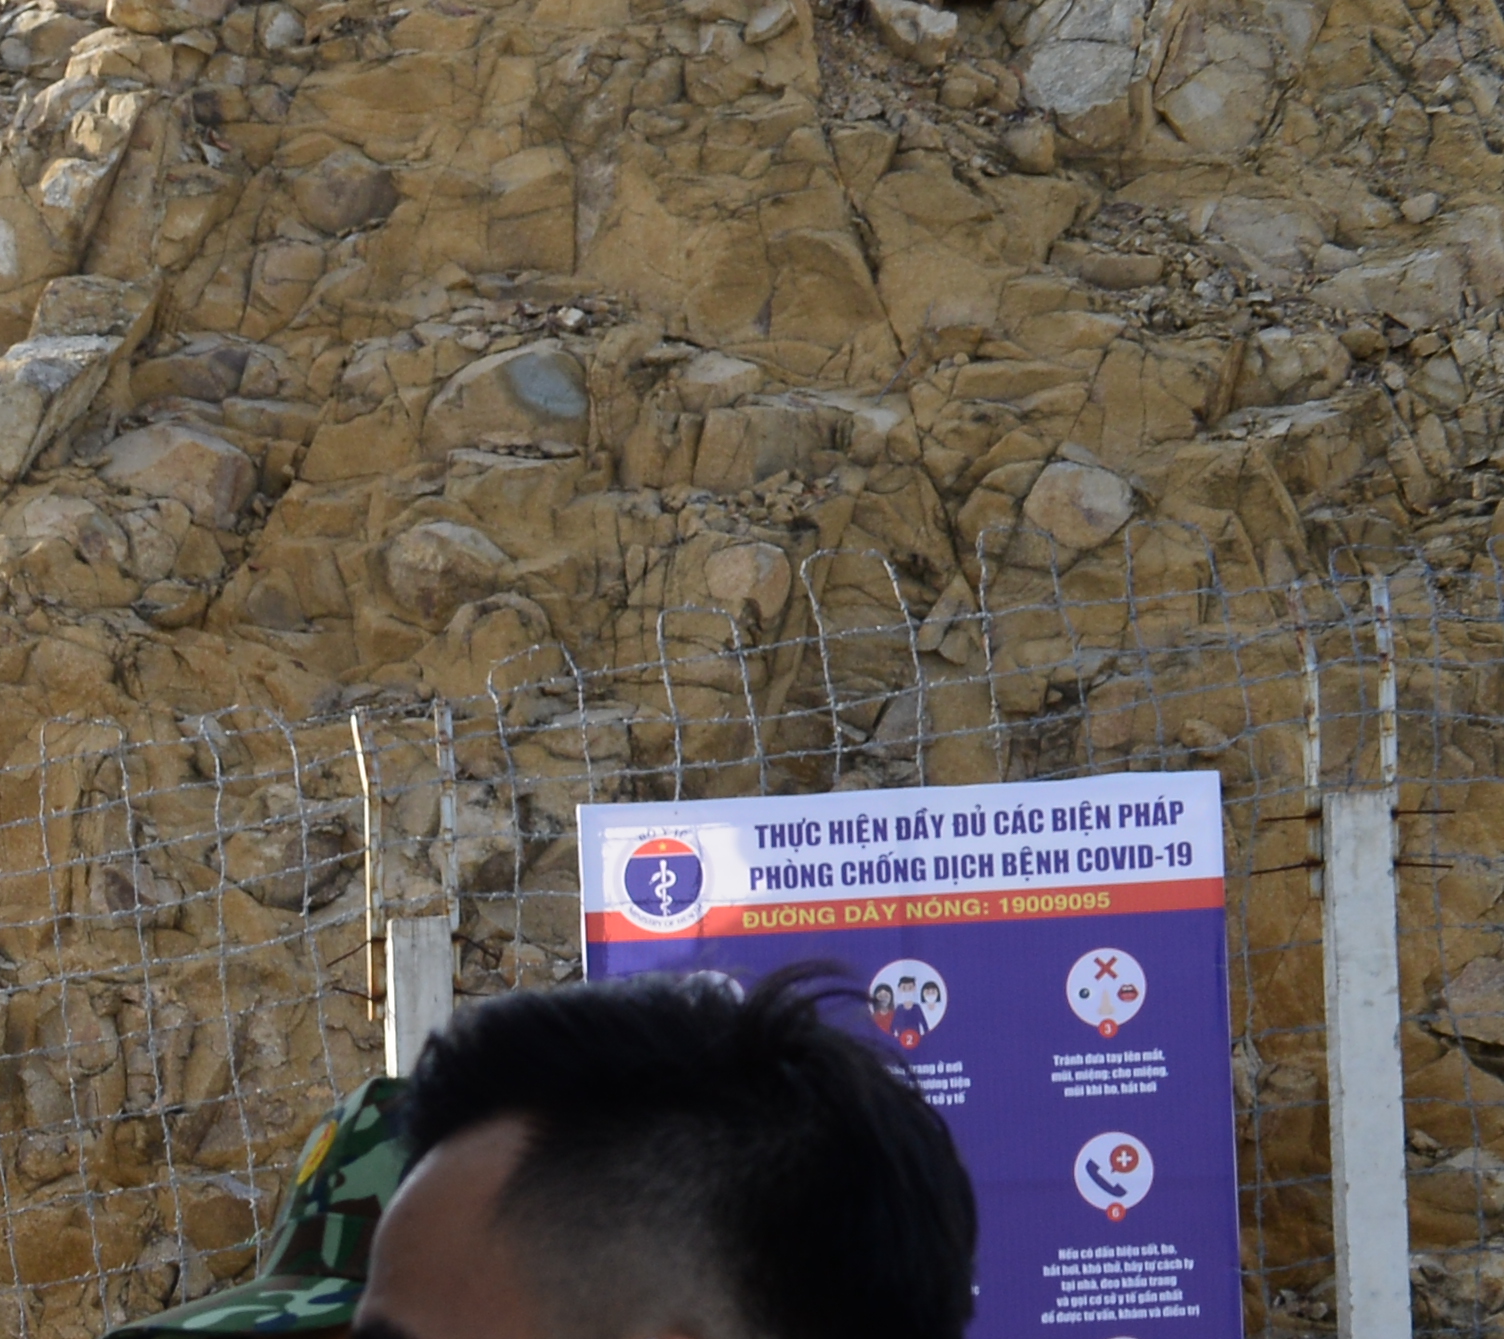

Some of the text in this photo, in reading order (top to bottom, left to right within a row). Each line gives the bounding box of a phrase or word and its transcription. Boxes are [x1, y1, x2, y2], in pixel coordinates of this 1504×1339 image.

[755, 818, 822, 853] THỰC
[828, 814, 888, 848] HIỆN
[952, 804, 986, 838] ĐỦ
[993, 803, 1044, 836] CÁC
[1052, 800, 1111, 836] BIỆN
[1118, 795, 1185, 829] PHÁP
[750, 841, 1193, 891] PHÒNG CHỐNG DỊCH BỆNH COVID-19
[742, 892, 1111, 929] ĐƯỜNG DÂY NÓNG: 19009095
[906, 1034, 913, 1045] 2
[1105, 1024, 1112, 1035] 3
[1112, 1207, 1120, 1218] 6
